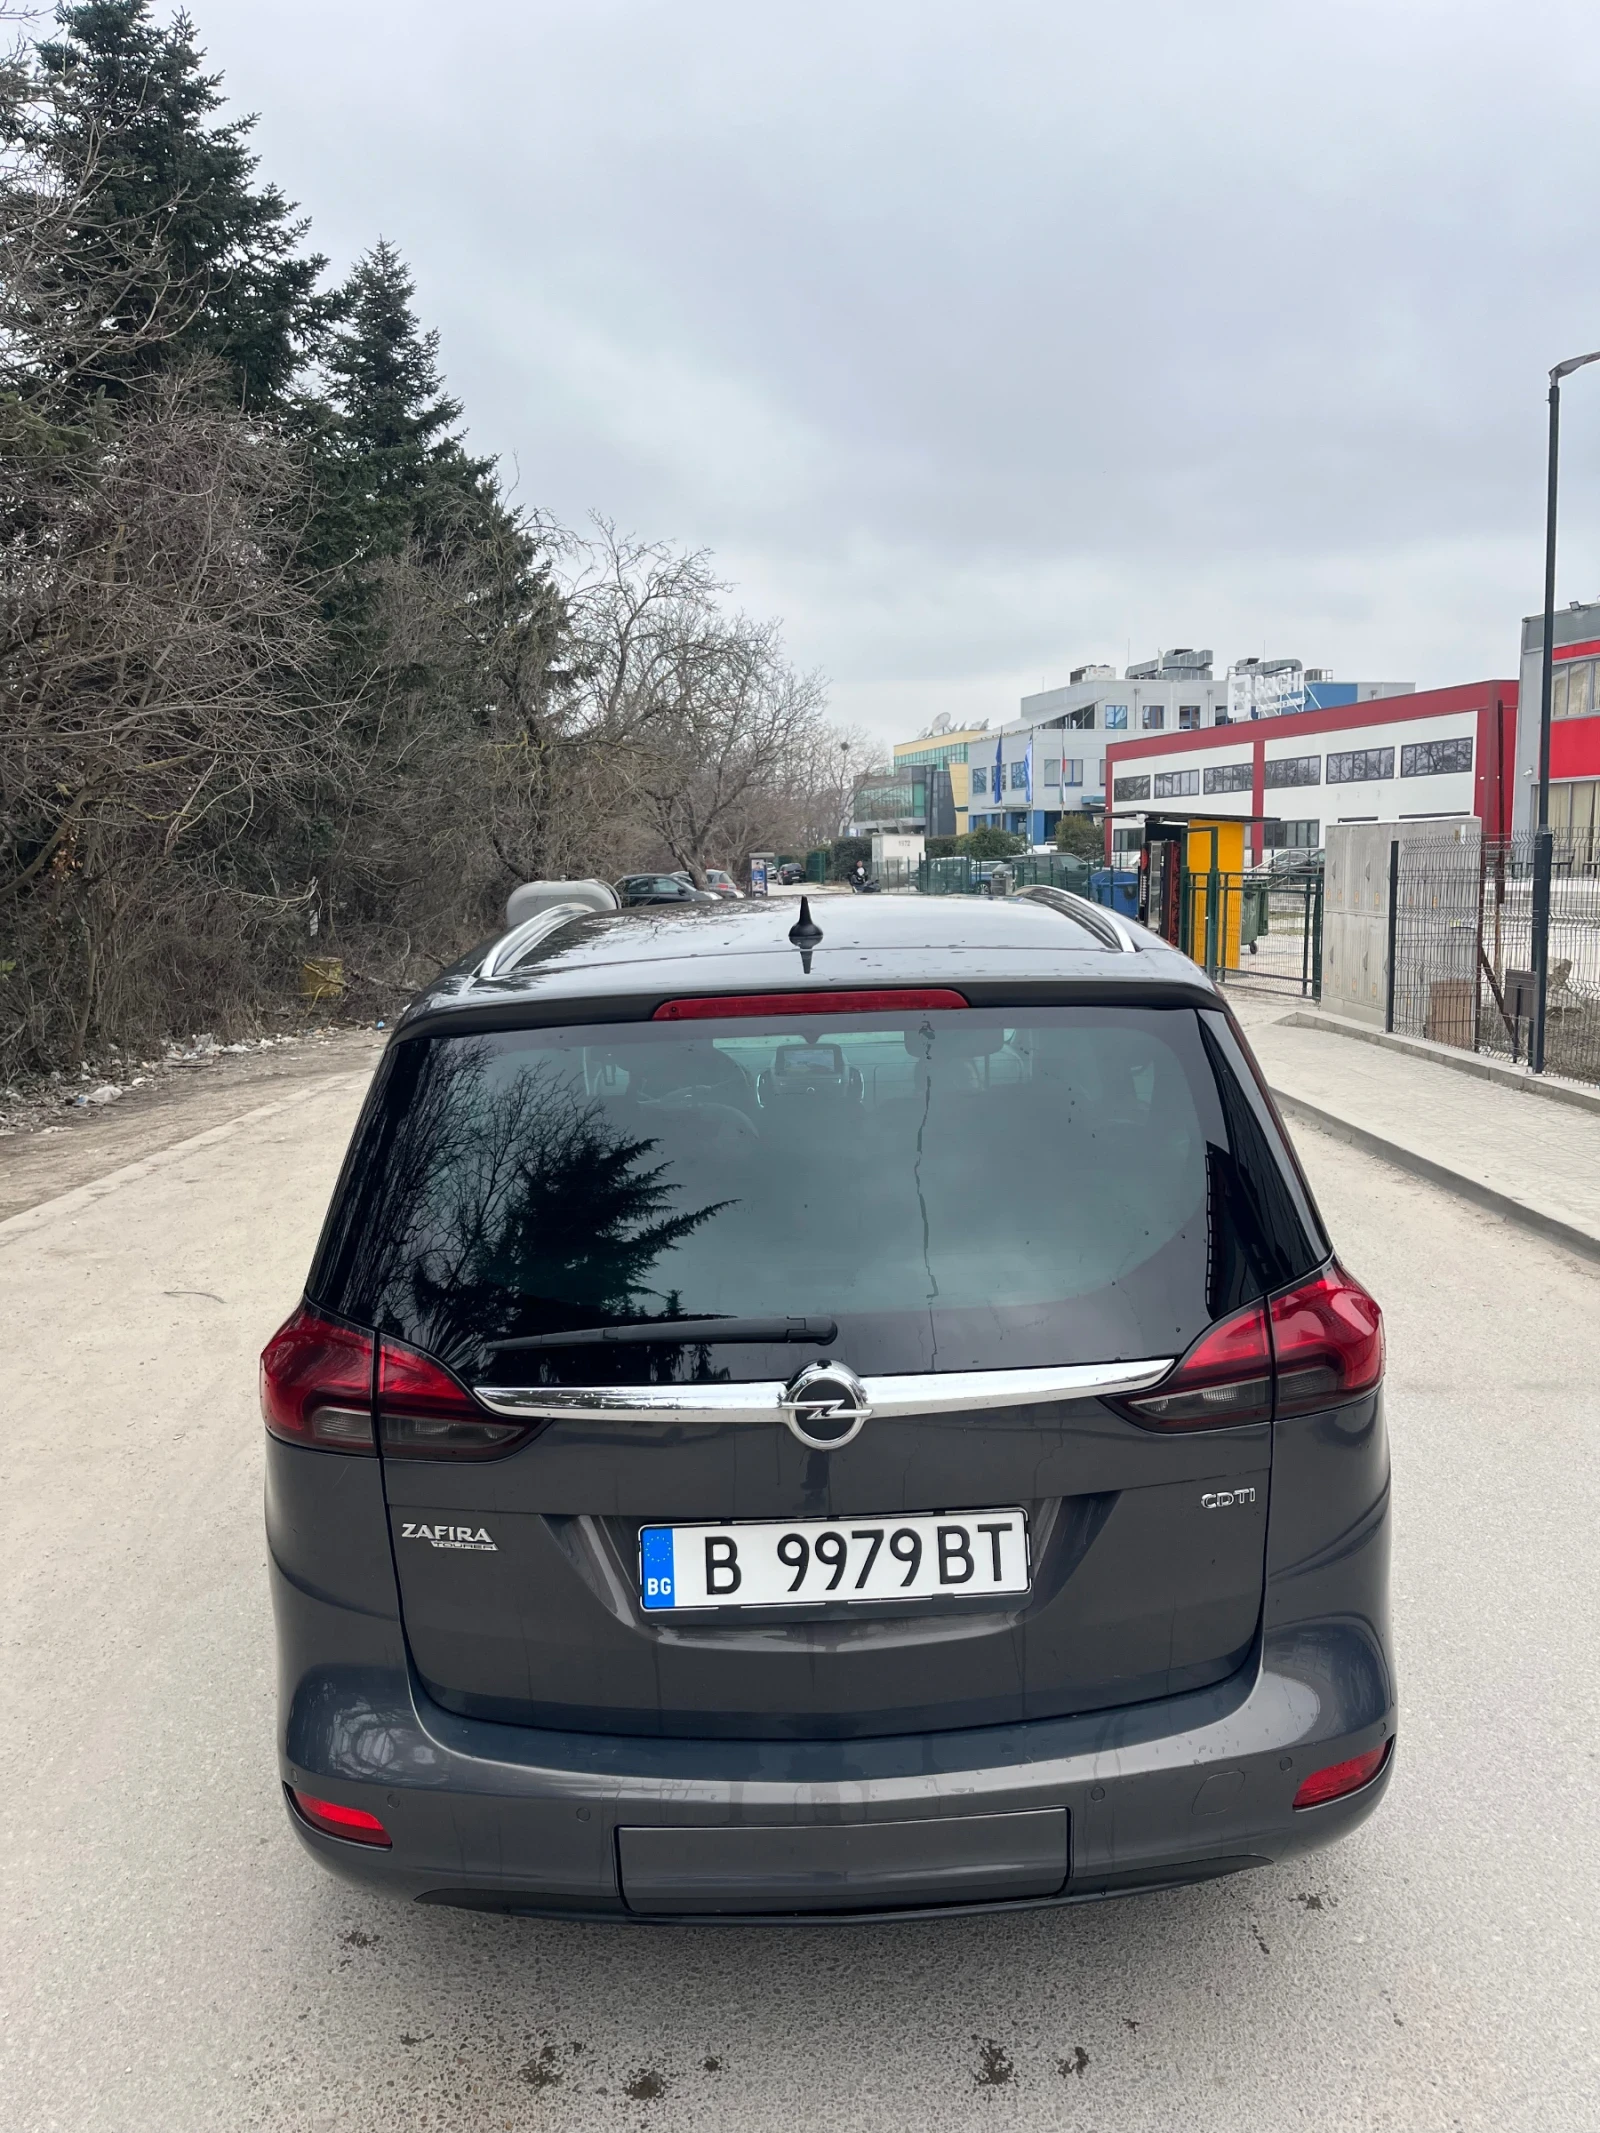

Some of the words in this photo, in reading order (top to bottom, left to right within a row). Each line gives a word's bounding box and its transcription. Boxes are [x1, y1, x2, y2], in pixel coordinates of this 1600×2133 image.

[1201, 1487, 1256, 1509] CDTI
[401, 1523, 493, 1543] ZAFIRA
[432, 1541, 496, 1550] TOURER
[704, 1536, 742, 1595] B
[647, 1577, 672, 1595] BG
